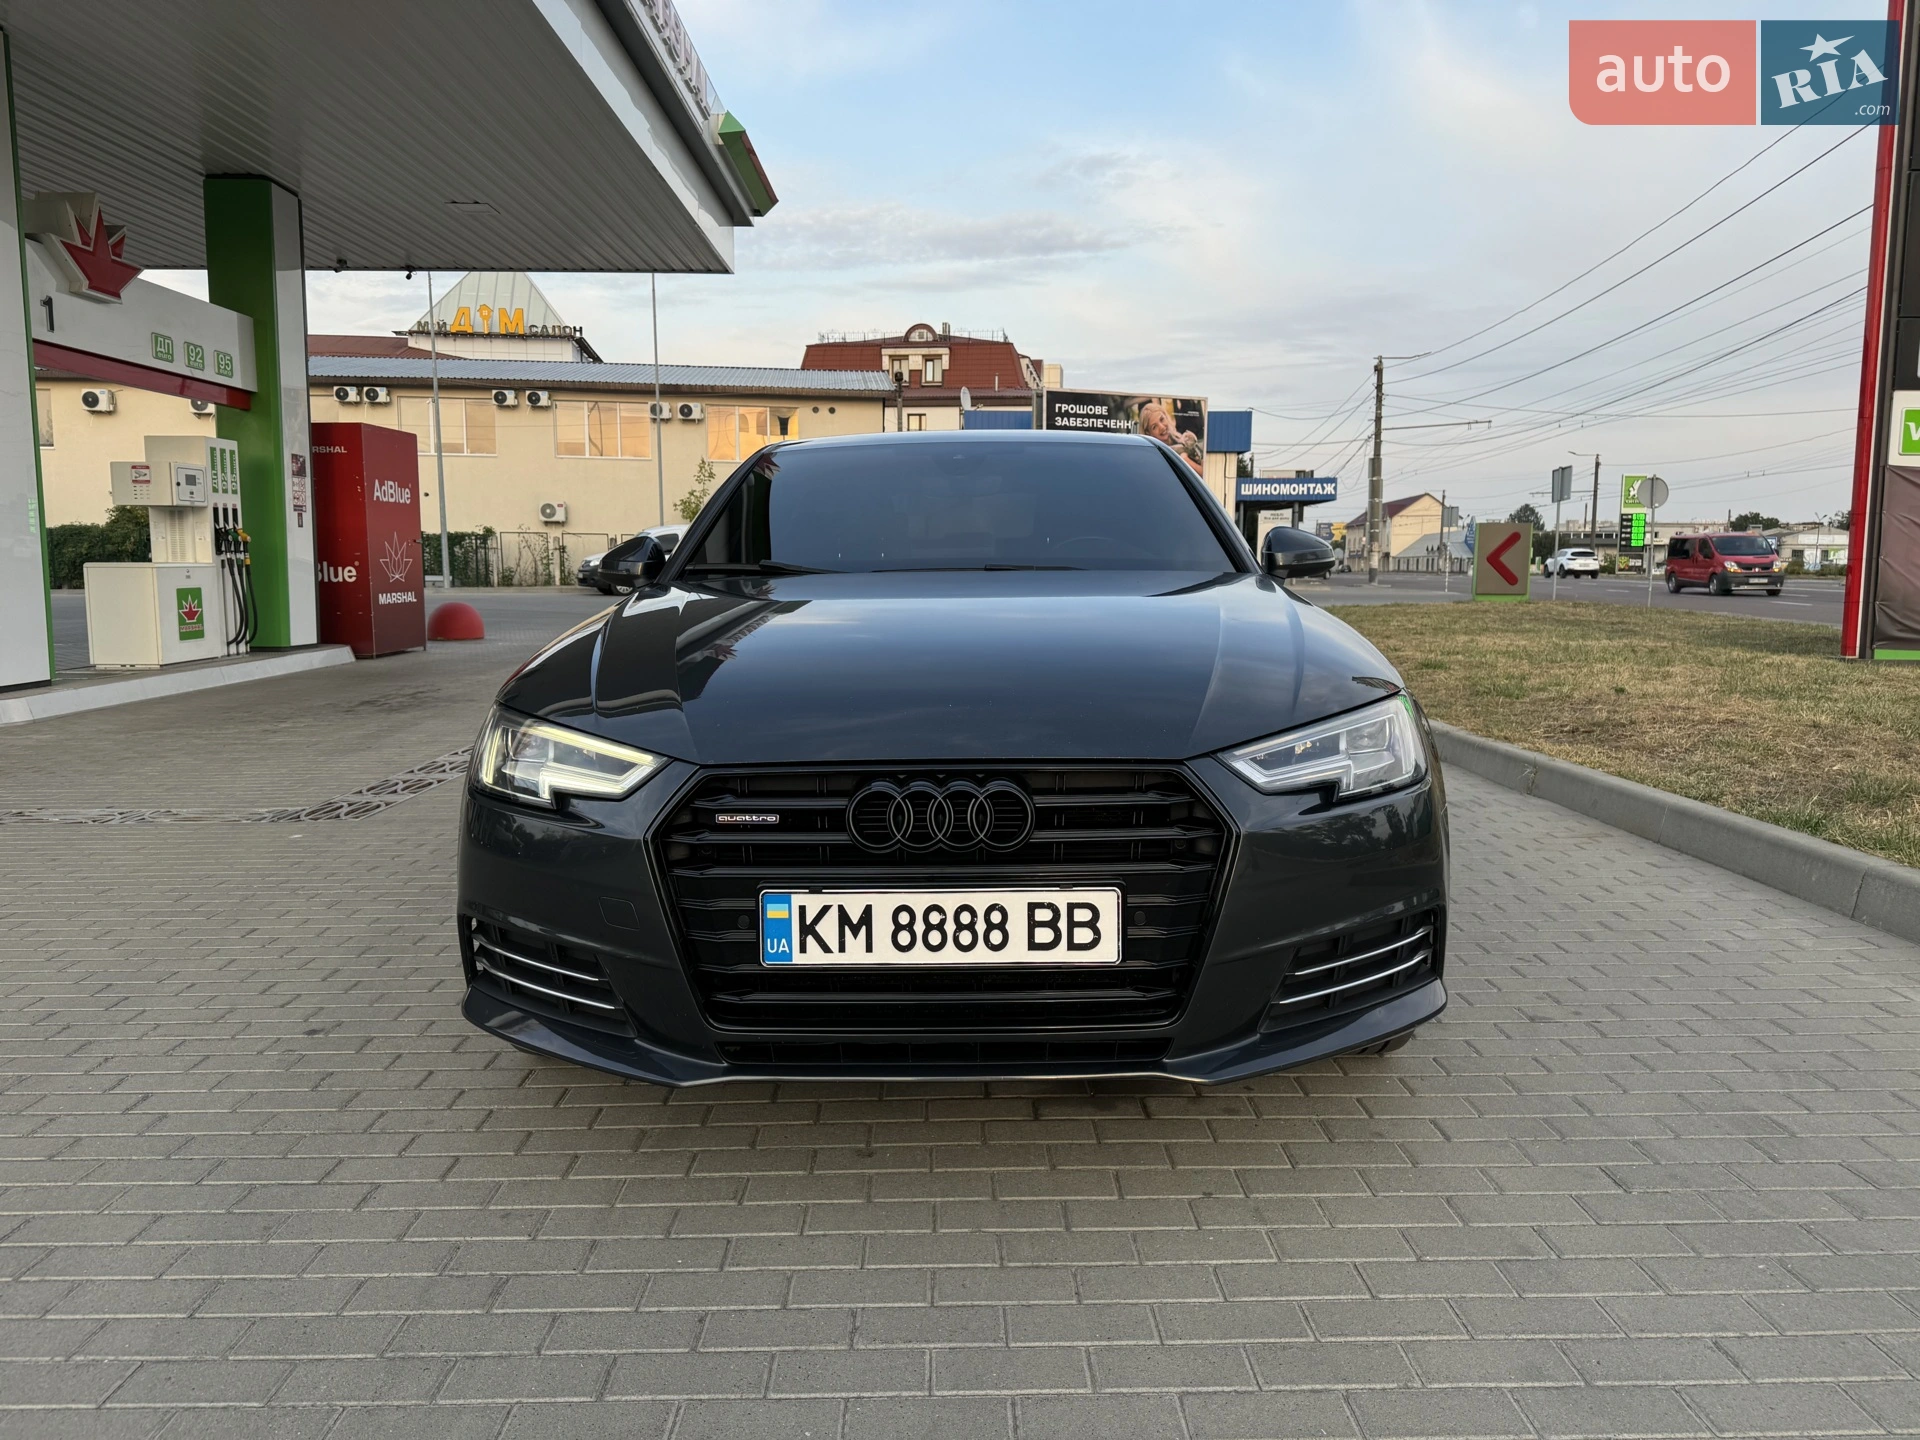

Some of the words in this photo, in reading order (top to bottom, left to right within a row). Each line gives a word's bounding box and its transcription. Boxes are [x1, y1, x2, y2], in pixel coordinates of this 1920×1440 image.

[40, 295, 55, 333] 1
[417, 319, 448, 333] МЙ
[157, 337, 172, 354] ДП
[189, 345, 203, 363] 92
[219, 354, 232, 371] 95
[1055, 403, 1109, 416] ГРОШОВЕ
[312, 445, 348, 454] RSHAL
[373, 479, 412, 505] AdBlue
[1240, 482, 1336, 496] ШИНОМОНТАЖ
[378, 591, 417, 605] MARSHAL
[718, 815, 777, 823] quattro
[798, 903, 874, 954] KM
[891, 903, 1009, 953] 8888
[1027, 901, 1101, 952] BB
[767, 938, 790, 954] UA
